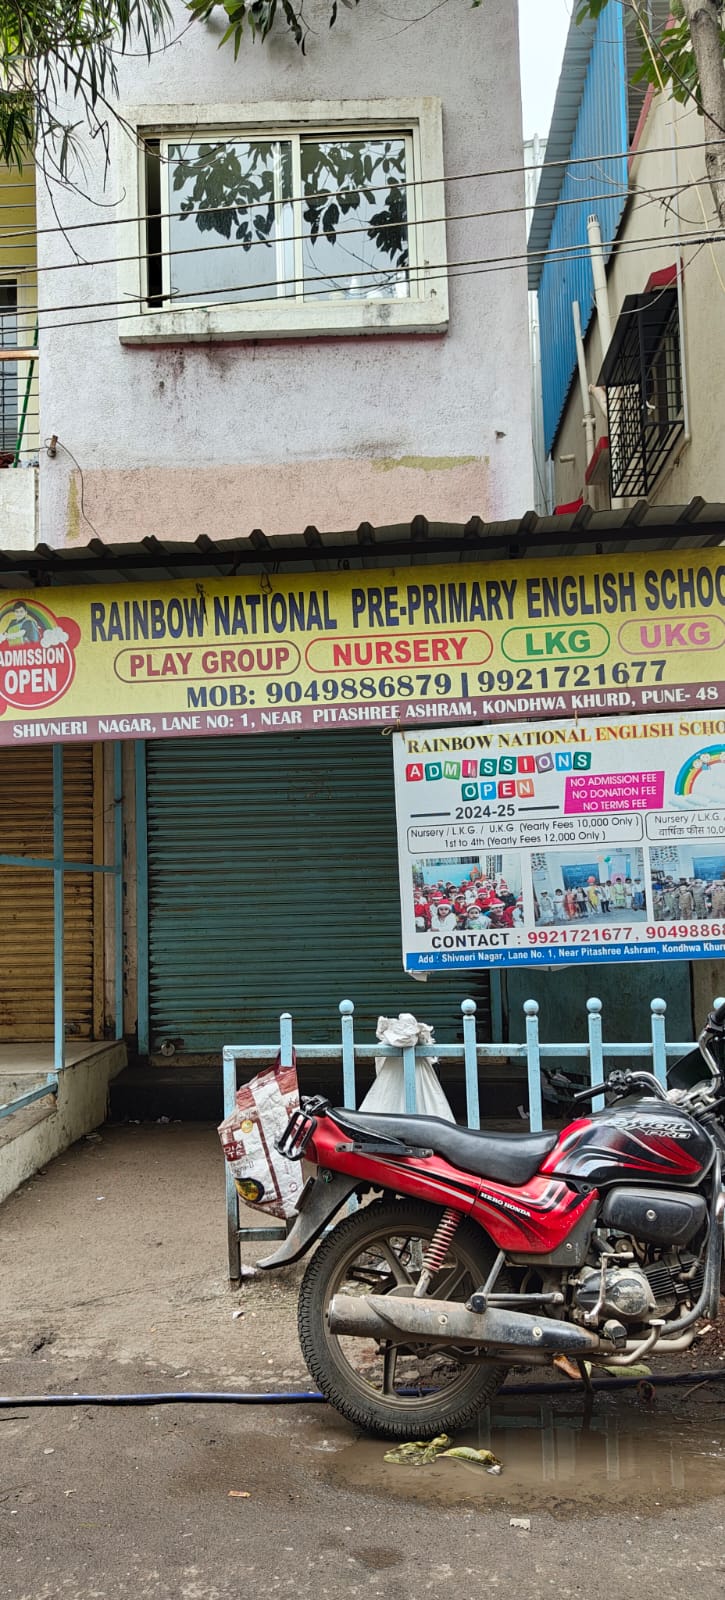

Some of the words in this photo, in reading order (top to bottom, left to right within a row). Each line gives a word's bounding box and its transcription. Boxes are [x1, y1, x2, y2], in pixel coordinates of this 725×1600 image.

[90, 597, 206, 642] RAINBOW
[213, 590, 338, 636] NATIONAL
[352, 579, 517, 628] PRE-PRIMARY
[526, 571, 636, 618] ENGLISH
[525, 629, 591, 656] LKG
[640, 622, 711, 649] UKG
[130, 652, 193, 677] PLAY
[201, 647, 290, 673] GROUP
[333, 636, 468, 666] NURSERY
[4, 667, 57, 695] OPEN
[187, 685, 255, 708] MOB:
[266, 672, 451, 704] 9049886879
[477, 660, 667, 693] 9921721677
[13, 721, 87, 738] SHIVNERI
[98, 718, 157, 735] NAGAR,
[162, 716, 201, 731] LANE
[206, 714, 234, 729] NO:
[261, 710, 302, 726] NEAR
[313, 705, 400, 723] PITASHREE
[405, 701, 477, 718] ASHRAM,
[483, 697, 567, 715] KONDHWA
[571, 693, 636, 710] KHURD,
[641, 688, 691, 705] PUNE-
[695, 686, 718, 700] 48
[407, 734, 492, 753] RAINBOW
[498, 728, 591, 748] NATIONAL
[595, 722, 674, 741] ENGLISH
[408, 752, 589, 779] ADMISSIONS
[463, 780, 531, 799] OPEN
[570, 778, 586, 787] NO
[588, 775, 640, 787] ADMISSION
[641, 773, 657, 783] FEE
[572, 790, 588, 799] NO
[590, 787, 640, 798] DONATION
[641, 786, 657, 796] FEE
[455, 804, 516, 820] 2024-25
[583, 801, 599, 811] NO
[600, 799, 630, 810] TERMS
[632, 798, 648, 808] FEE
[410, 828, 444, 839] Nursery
[552, 820, 574, 830] Fees
[578, 818, 609, 829] 10,000
[612, 816, 633, 828] Only
[654, 815, 689, 825] Nursery
[444, 838, 457, 848] 1st
[458, 837, 468, 847] to
[470, 836, 485, 847] 4th
[519, 833, 541, 844] Fees
[544, 831, 576, 843] 12,000
[578, 830, 600, 842] Only
[418, 954, 434, 964] Add
[441, 952, 476, 963] Shivneri
[508, 950, 528, 960] Lane
[530, 949, 545, 960] No.
[558, 948, 579, 958] Near
[581, 946, 622, 957] Pitashree
[662, 943, 702, 953] Kondhwa
[703, 941, 725, 952] Khur
[431, 932, 510, 949] CONTACT
[480, 1191, 504, 1206] HERO
[503, 1201, 531, 1217] HONDA
